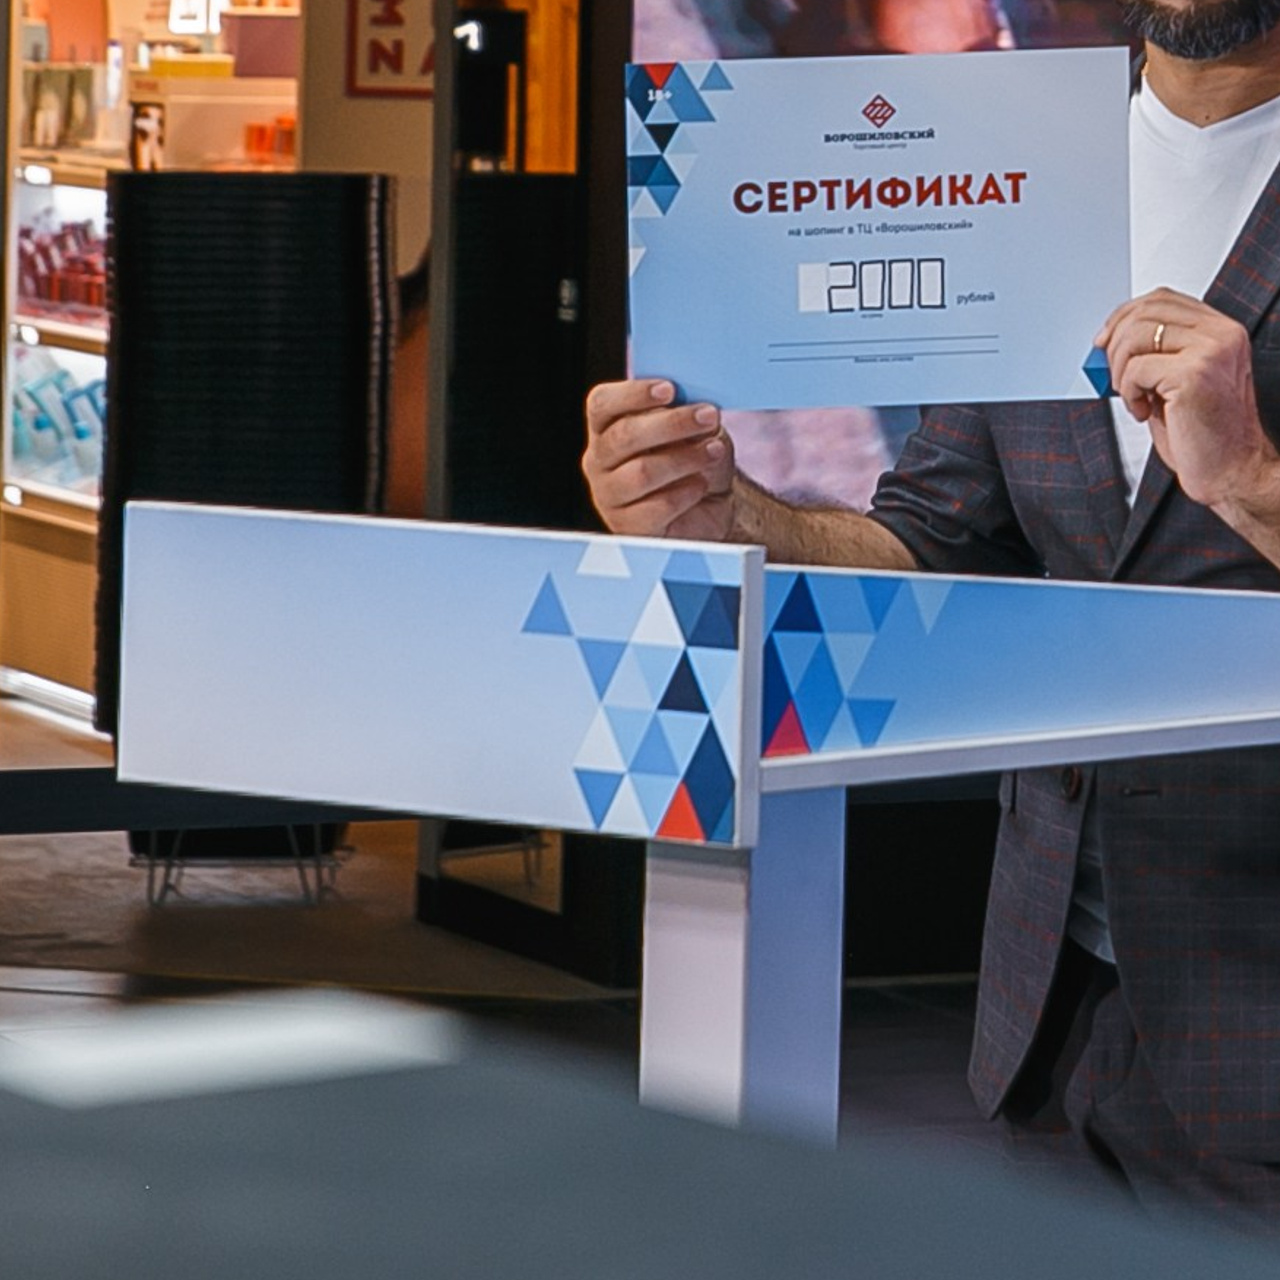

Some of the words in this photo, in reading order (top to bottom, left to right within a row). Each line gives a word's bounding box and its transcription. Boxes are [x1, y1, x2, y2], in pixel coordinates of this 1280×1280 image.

[824, 128, 935, 143] ВОРОШИЛОВСКИЙ
[733, 171, 1027, 214] СЕРТИФИКАТ
[787, 228, 801, 237] на
[804, 225, 845, 237] шопинг
[847, 226, 854, 235] в
[856, 223, 872, 234] ТЦ
[875, 219, 973, 235] «Ворошиловский»
[828, 258, 946, 313] 2000
[956, 291, 996, 305] рублей
